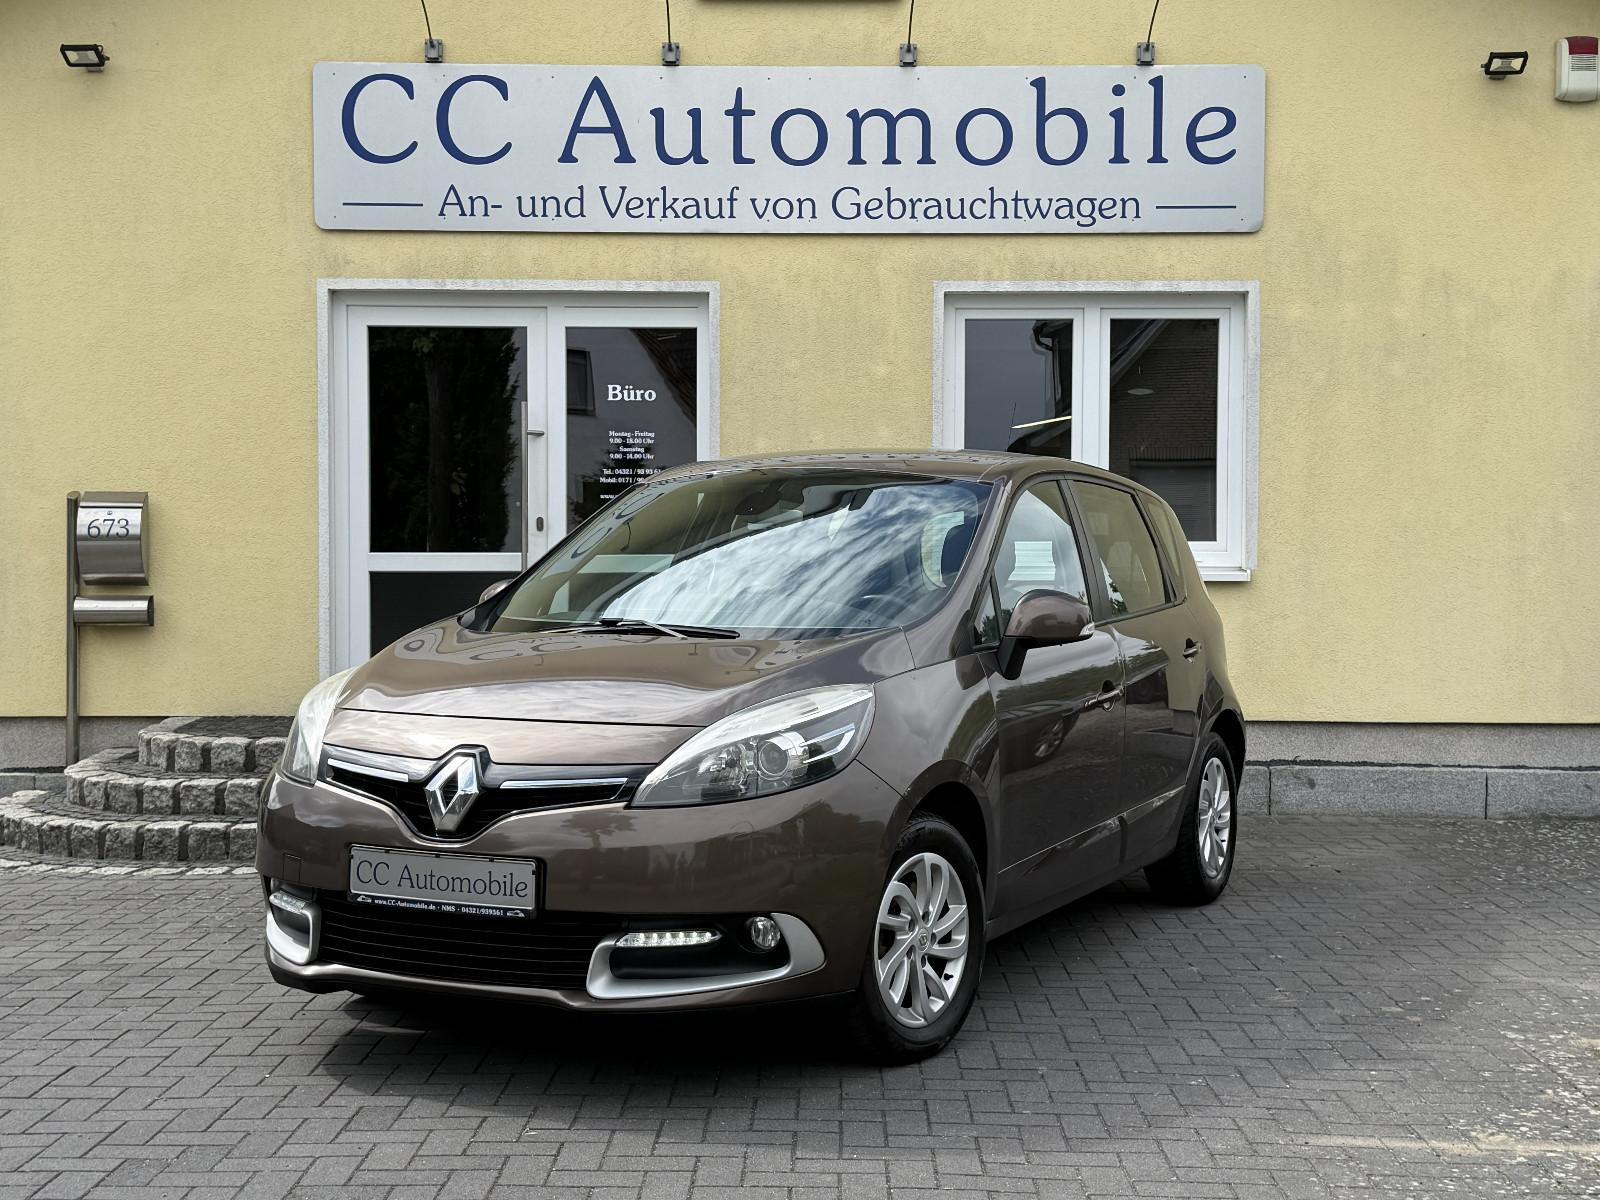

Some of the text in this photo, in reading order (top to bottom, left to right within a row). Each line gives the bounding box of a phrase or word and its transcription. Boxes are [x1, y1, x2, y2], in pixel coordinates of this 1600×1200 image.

[341, 73, 1238, 167] CC Automobile
[437, 184, 1142, 228] An- und Verkauf von Gebrauchtwagen
[607, 384, 657, 402] Büro
[634, 430, 655, 438] Freitag
[87, 518, 130, 538] 673
[356, 860, 528, 898] CC Automobile
[442, 904, 456, 912] NMS
